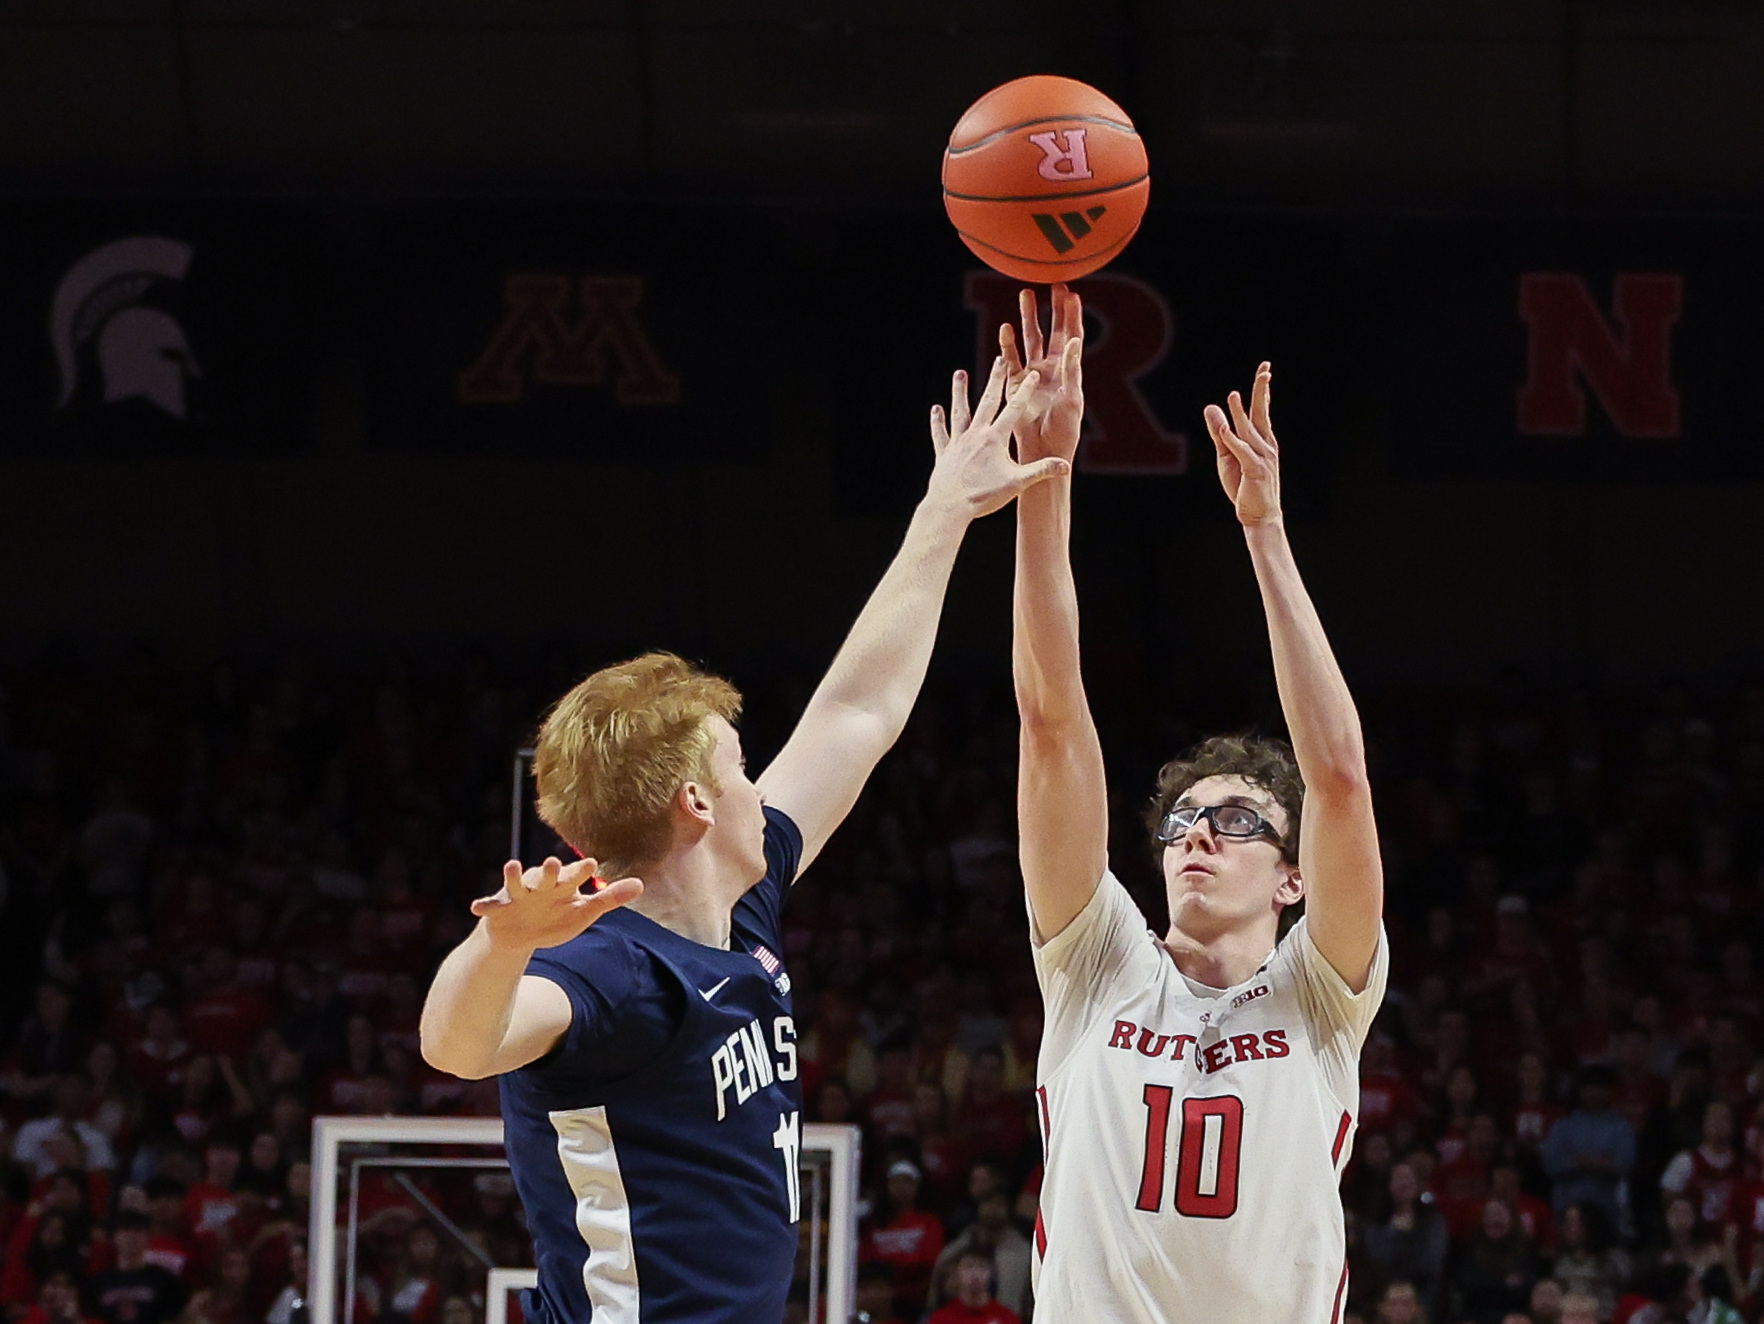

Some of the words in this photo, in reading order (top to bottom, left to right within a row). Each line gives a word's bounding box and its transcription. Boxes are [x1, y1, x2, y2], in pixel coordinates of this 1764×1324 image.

[1029, 128, 1094, 182] R
[457, 273, 682, 405] M
[1516, 271, 1686, 438] N
[1135, 1083, 1244, 1219] 10
